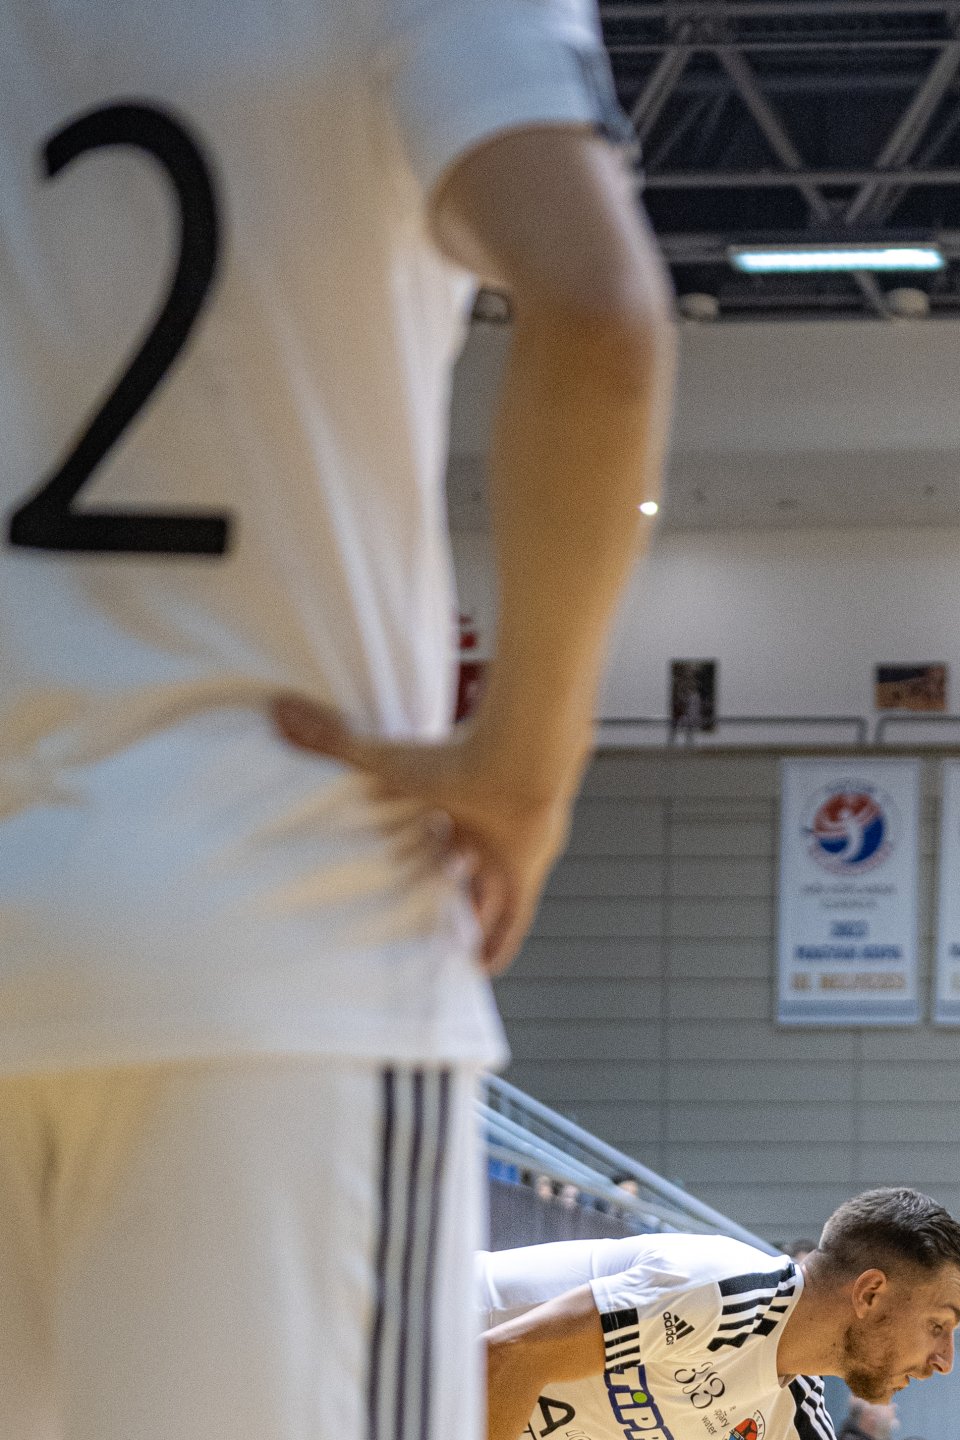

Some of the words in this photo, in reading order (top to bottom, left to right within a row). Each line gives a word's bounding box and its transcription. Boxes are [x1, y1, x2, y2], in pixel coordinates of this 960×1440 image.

[9, 103, 229, 555] 2
[663, 1311, 677, 1346] adidas
[701, 1415, 718, 1436] water
